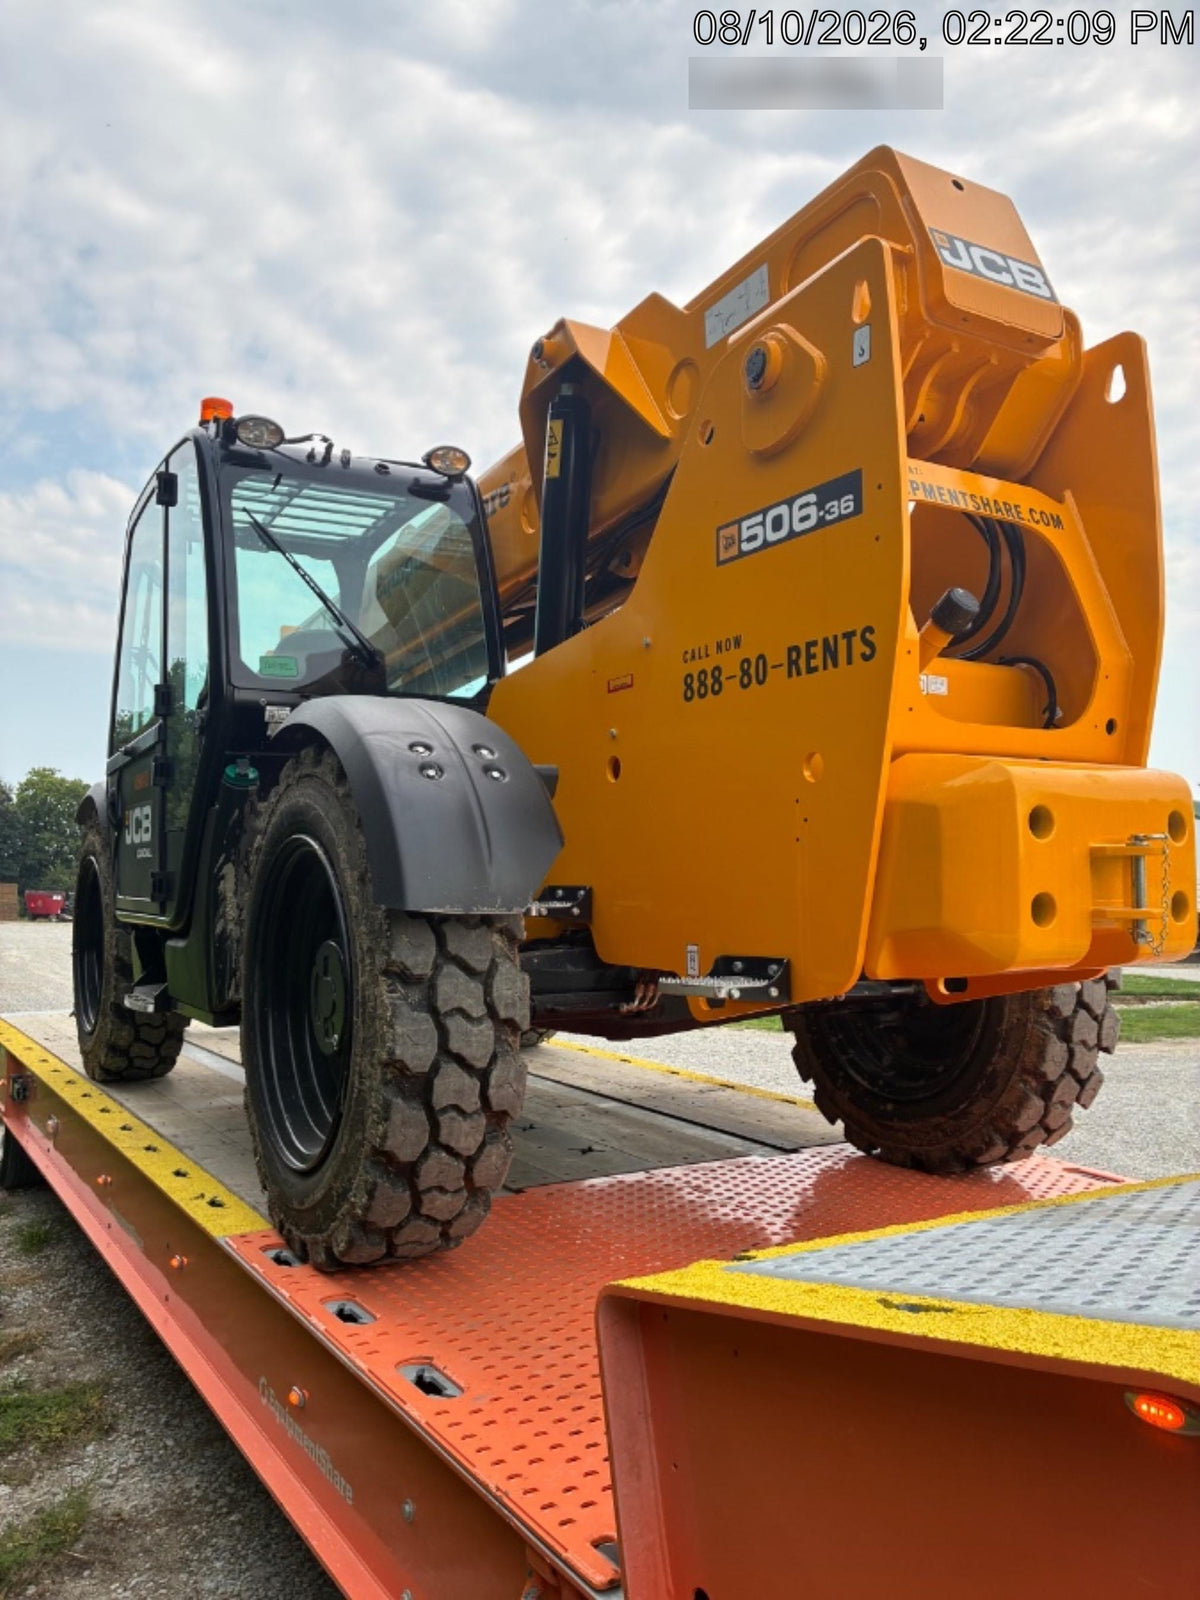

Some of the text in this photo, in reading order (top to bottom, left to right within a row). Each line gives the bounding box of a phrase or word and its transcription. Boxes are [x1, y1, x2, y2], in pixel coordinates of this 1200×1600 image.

[940, 239, 1053, 298] JCB
[908, 479, 1064, 530] PMENTSHARE.COM
[682, 635, 742, 664] CALL NOW
[683, 625, 877, 702] 888-80-RENTS
[125, 804, 152, 845] JCB
